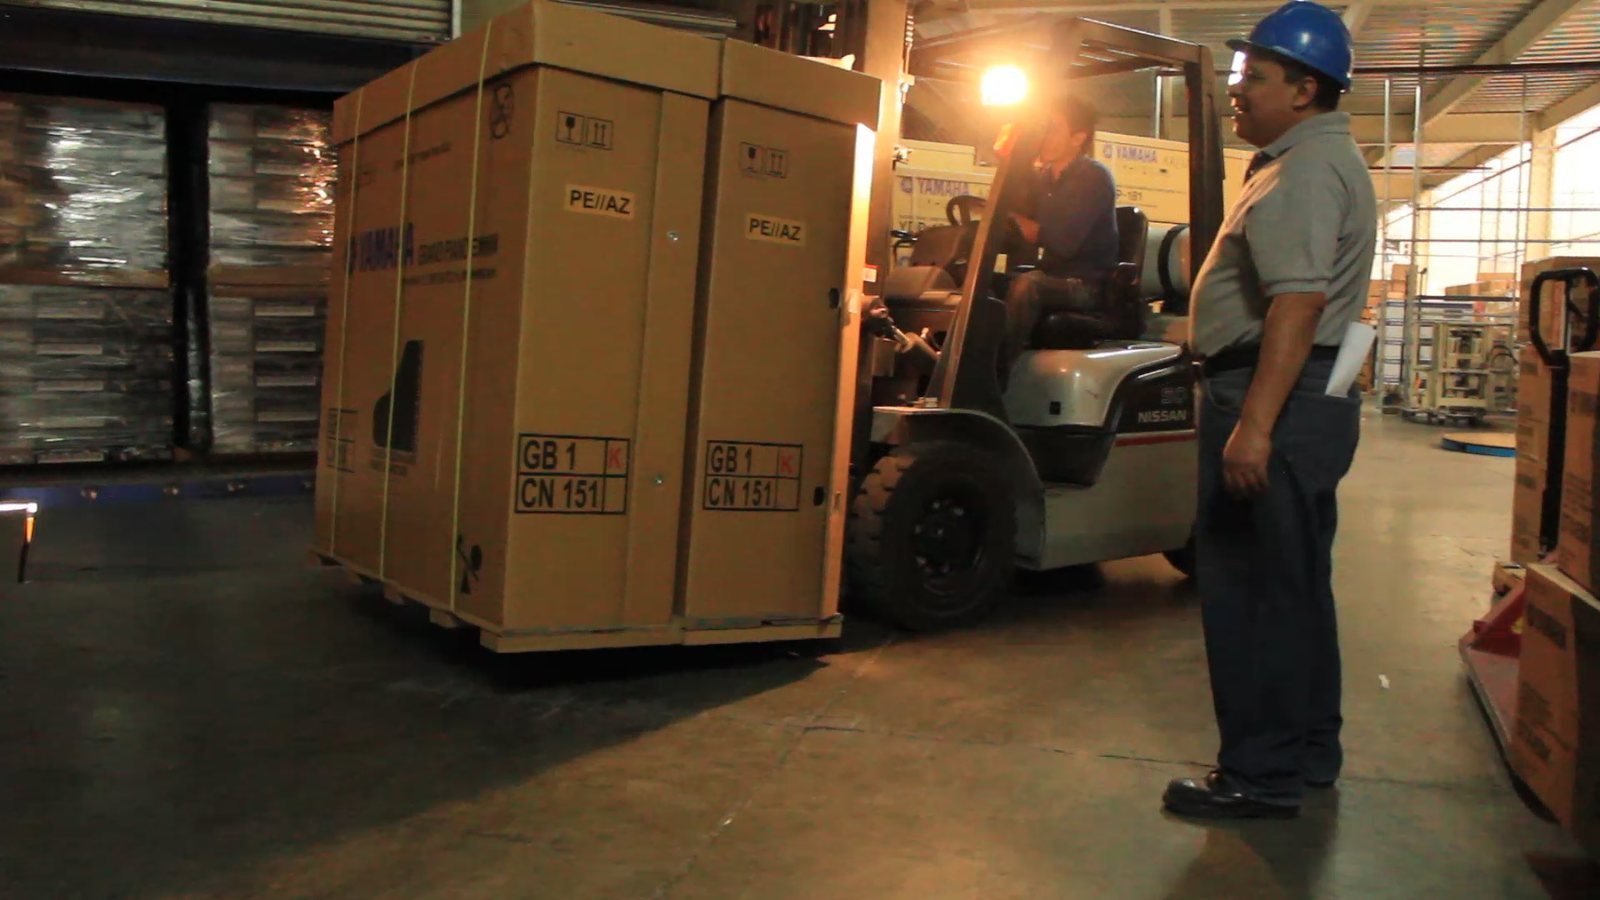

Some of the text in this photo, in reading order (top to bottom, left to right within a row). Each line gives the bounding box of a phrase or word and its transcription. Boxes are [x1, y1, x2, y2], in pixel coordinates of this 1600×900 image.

[1116, 145, 1157, 163] YAMAHA
[919, 178, 969, 197] YAMAHA
[569, 189, 631, 215] PE//AZ
[749, 217, 801, 241] PE//AZ
[1137, 410, 1187, 423] NISSAN
[523, 440, 576, 470] GB 1
[608, 447, 622, 470] K
[711, 445, 752, 473] GB 1
[780, 453, 795, 474] K
[521, 478, 598, 508] CN 151
[708, 478, 771, 506] CN 151
